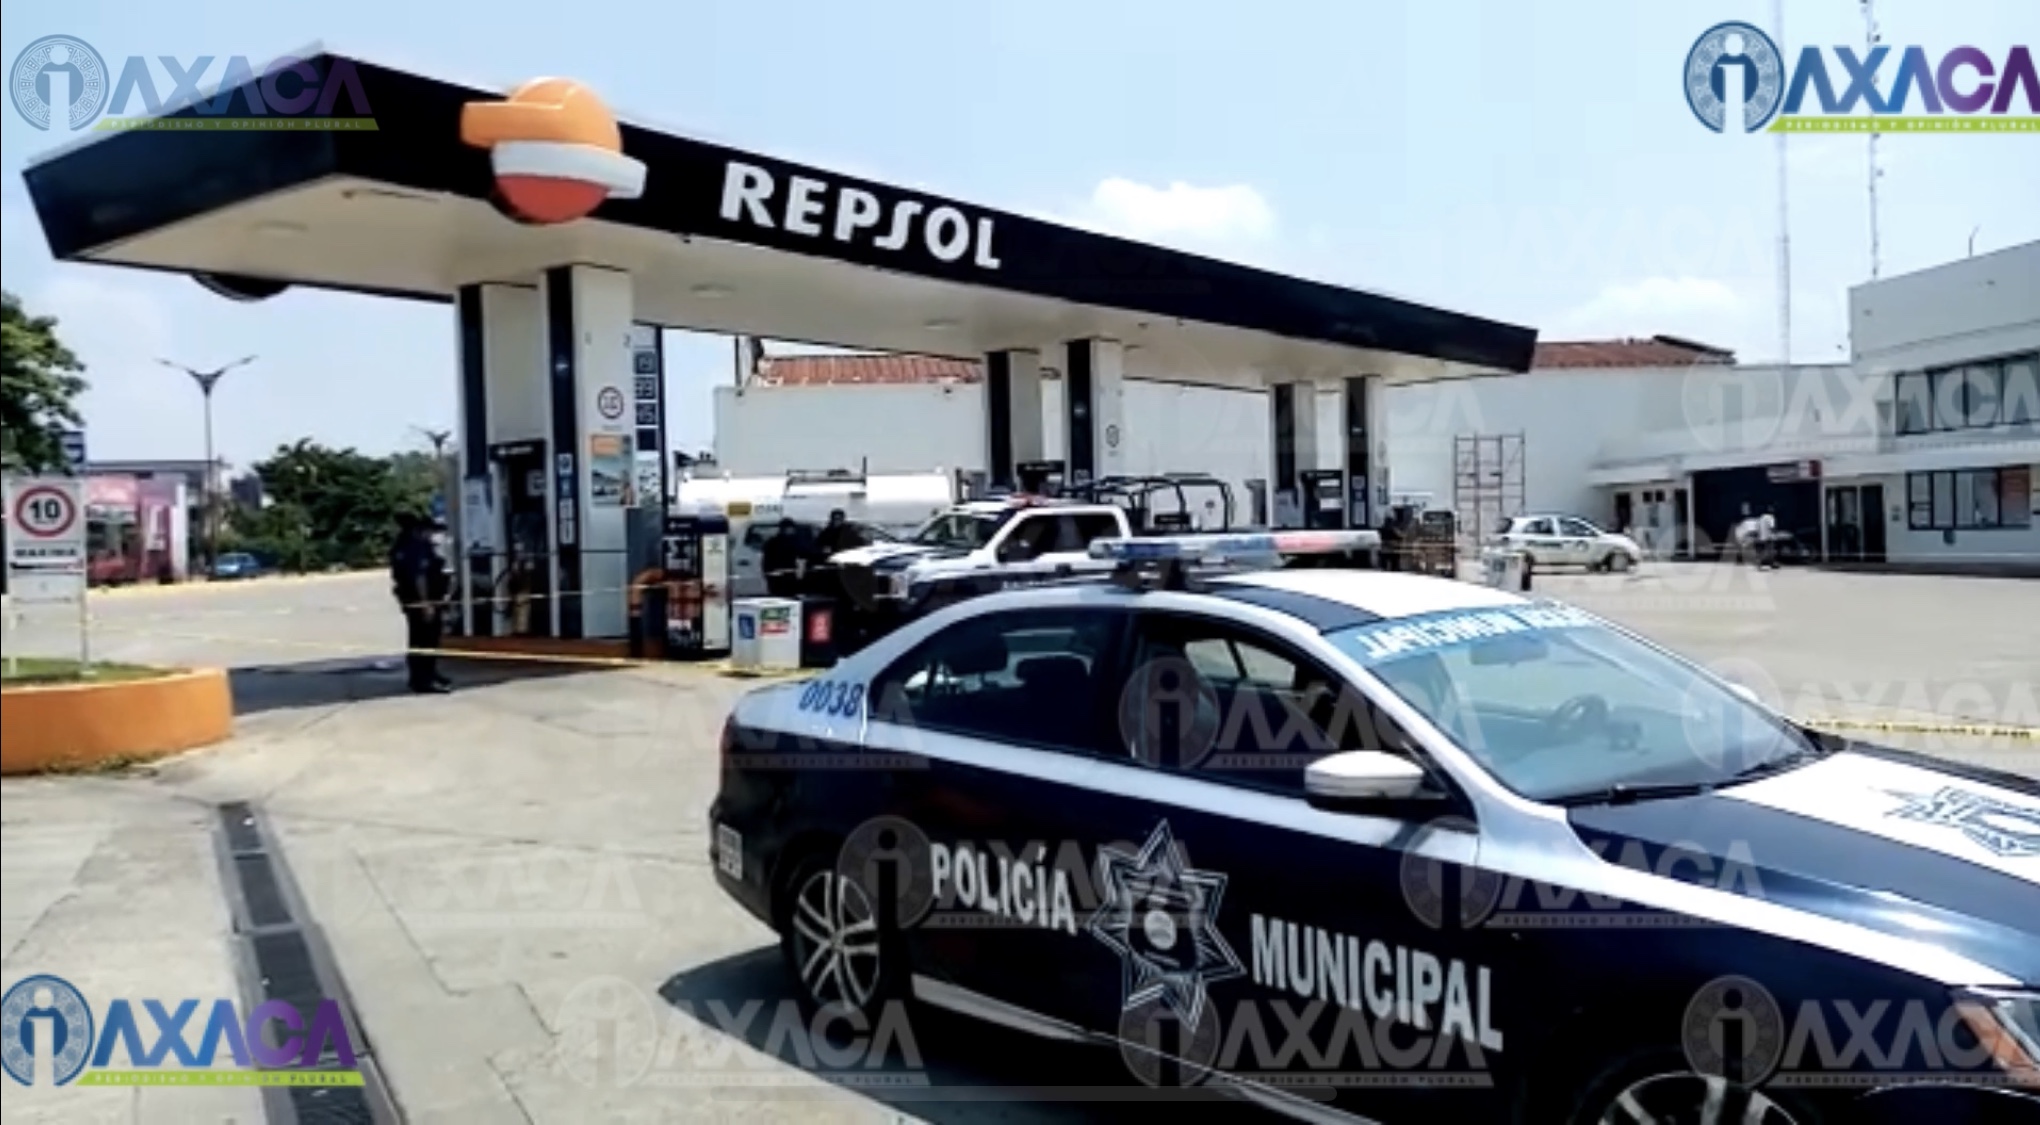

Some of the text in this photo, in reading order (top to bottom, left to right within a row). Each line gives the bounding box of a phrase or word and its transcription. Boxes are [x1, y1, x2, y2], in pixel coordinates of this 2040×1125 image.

[718, 160, 1001, 269] REPSOL
[29, 499, 61, 519] 10
[798, 680, 865, 717] 0038
[929, 842, 1079, 937] POLICÍA
[1250, 912, 1503, 1053] MUNICIPAL
